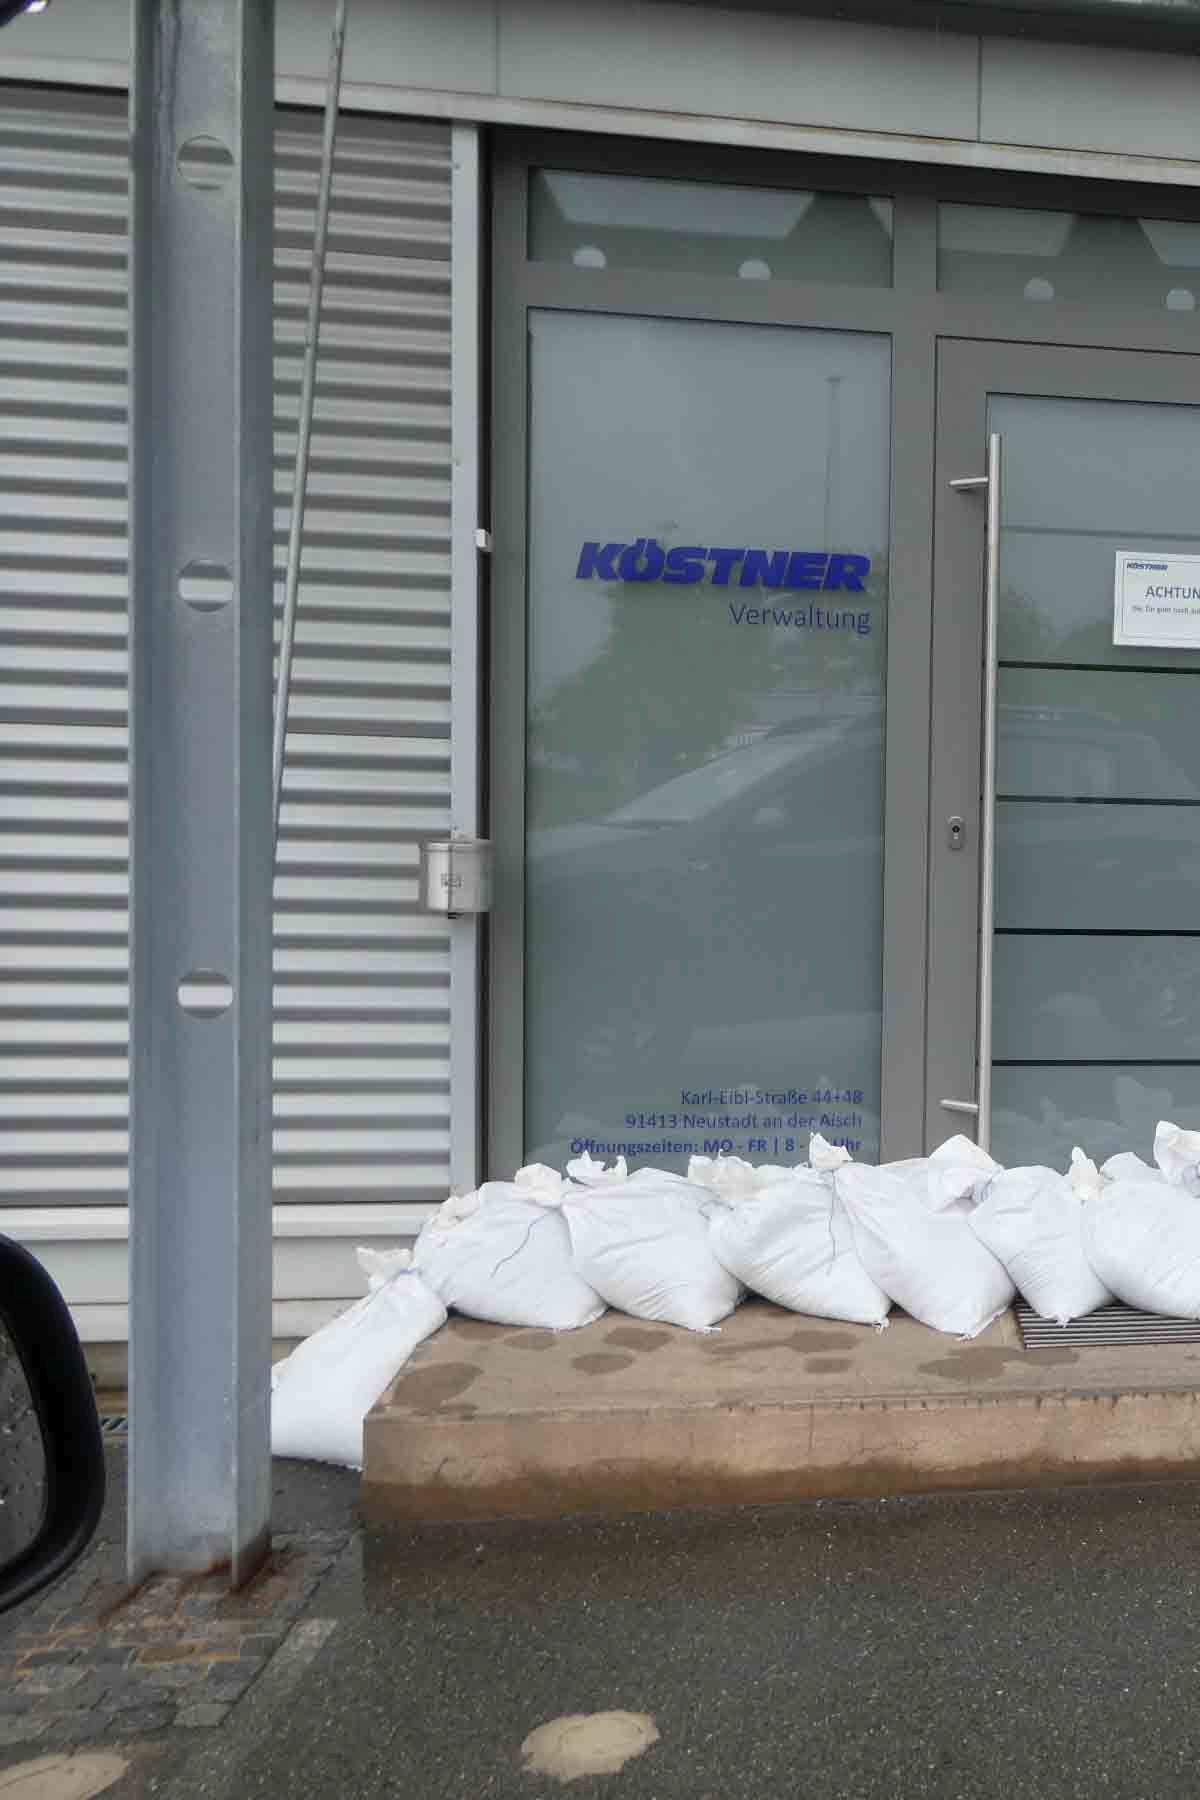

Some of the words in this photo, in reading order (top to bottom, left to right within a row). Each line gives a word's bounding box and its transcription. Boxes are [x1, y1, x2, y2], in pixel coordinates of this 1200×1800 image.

[575, 538, 871, 592] KÖSTNER
[728, 603, 871, 634] Verwaltung
[624, 1114, 678, 1129] 91413
[682, 1113, 759, 1129] Neustadt
[763, 1117, 783, 1129] an
[787, 1113, 815, 1129] der
[819, 1113, 862, 1129] Aisch
[569, 1137, 699, 1156] Öffnungszeiten:
[703, 1138, 735, 1153] MO
[748, 1138, 768, 1152] FR
[785, 1138, 794, 1152] 8
